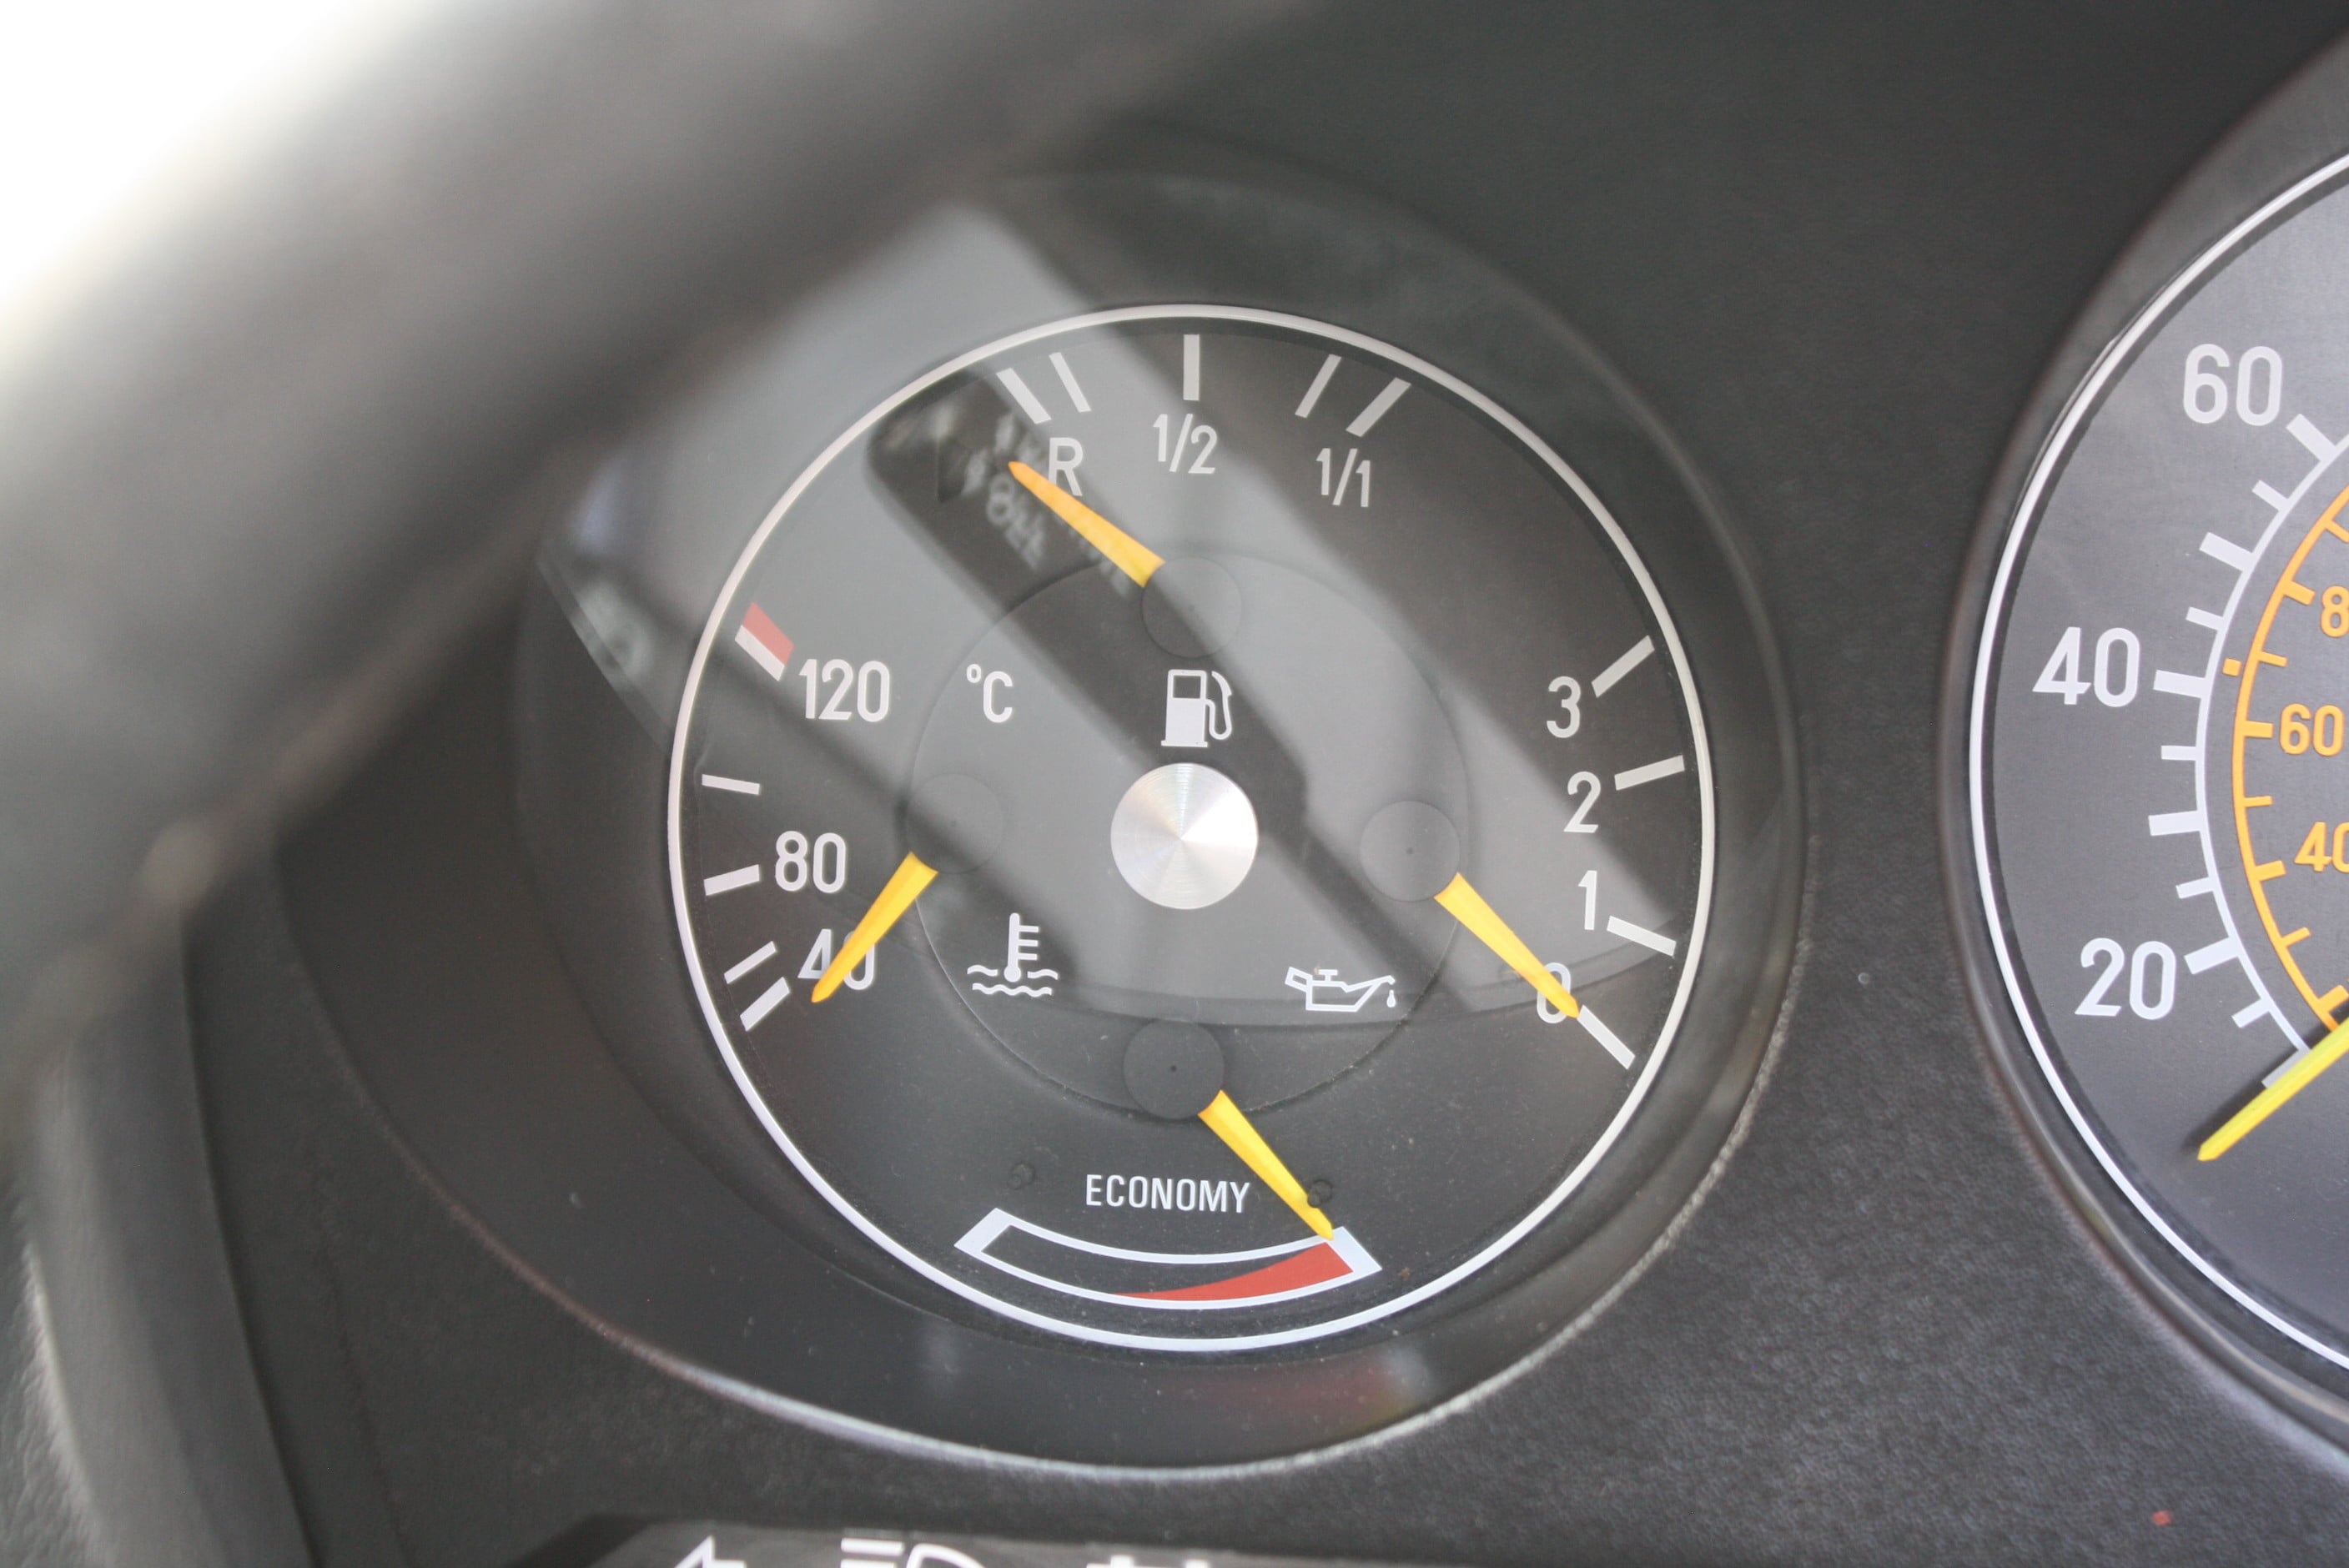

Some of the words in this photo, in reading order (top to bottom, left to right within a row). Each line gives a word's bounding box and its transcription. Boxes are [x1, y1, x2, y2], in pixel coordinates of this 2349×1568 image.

[2183, 343, 2283, 426] 60
[1048, 437, 1084, 497] R
[1153, 413, 1219, 475] 1/2
[1316, 448, 1371, 508] 1/1
[798, 658, 891, 723] 120
[2032, 626, 2140, 708] 40
[1547, 676, 1582, 738] 3
[2279, 703, 2345, 756] 60
[1563, 771, 1602, 833] 2
[775, 830, 846, 893] 80
[1577, 870, 1597, 931] 1
[1537, 962, 1572, 1024] 0
[2074, 937, 2177, 1021] 20
[1085, 1173, 1250, 1214] ECONOMY
